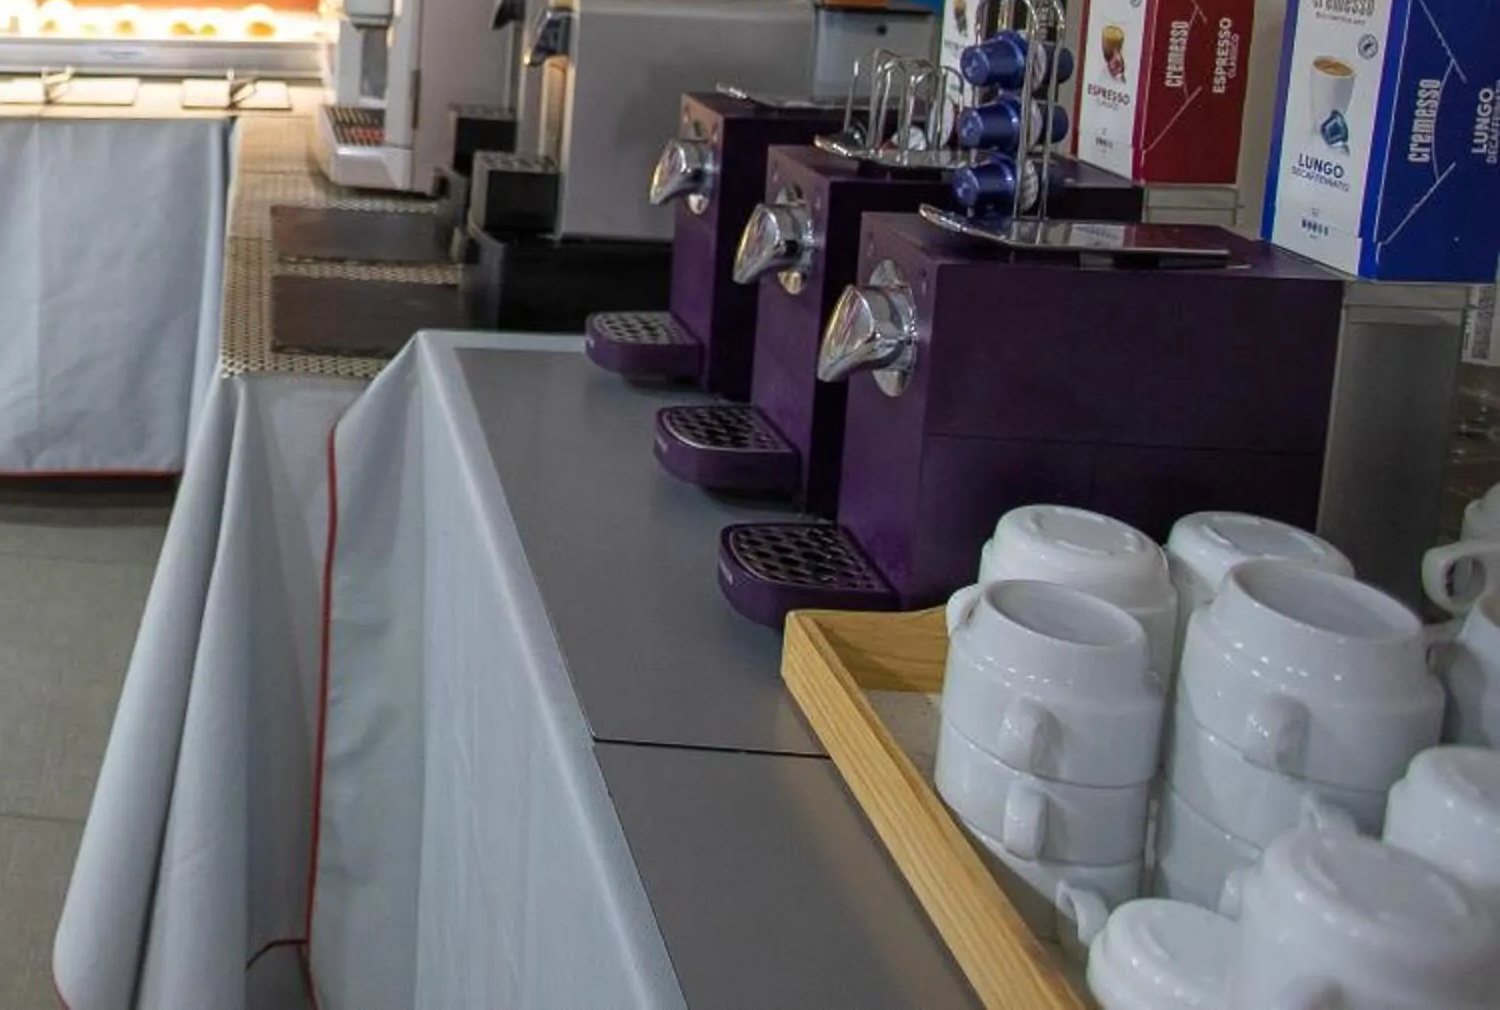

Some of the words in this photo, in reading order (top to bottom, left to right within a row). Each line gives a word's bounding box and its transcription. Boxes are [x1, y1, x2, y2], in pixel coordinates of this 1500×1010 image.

[1212, 17, 1233, 95] ESPRESSO
[1087, 83, 1131, 107] ESPRESSO
[1407, 78, 1441, 164] cremesso
[1471, 87, 1495, 155] LUNGO
[1297, 153, 1345, 180] LUNGO
